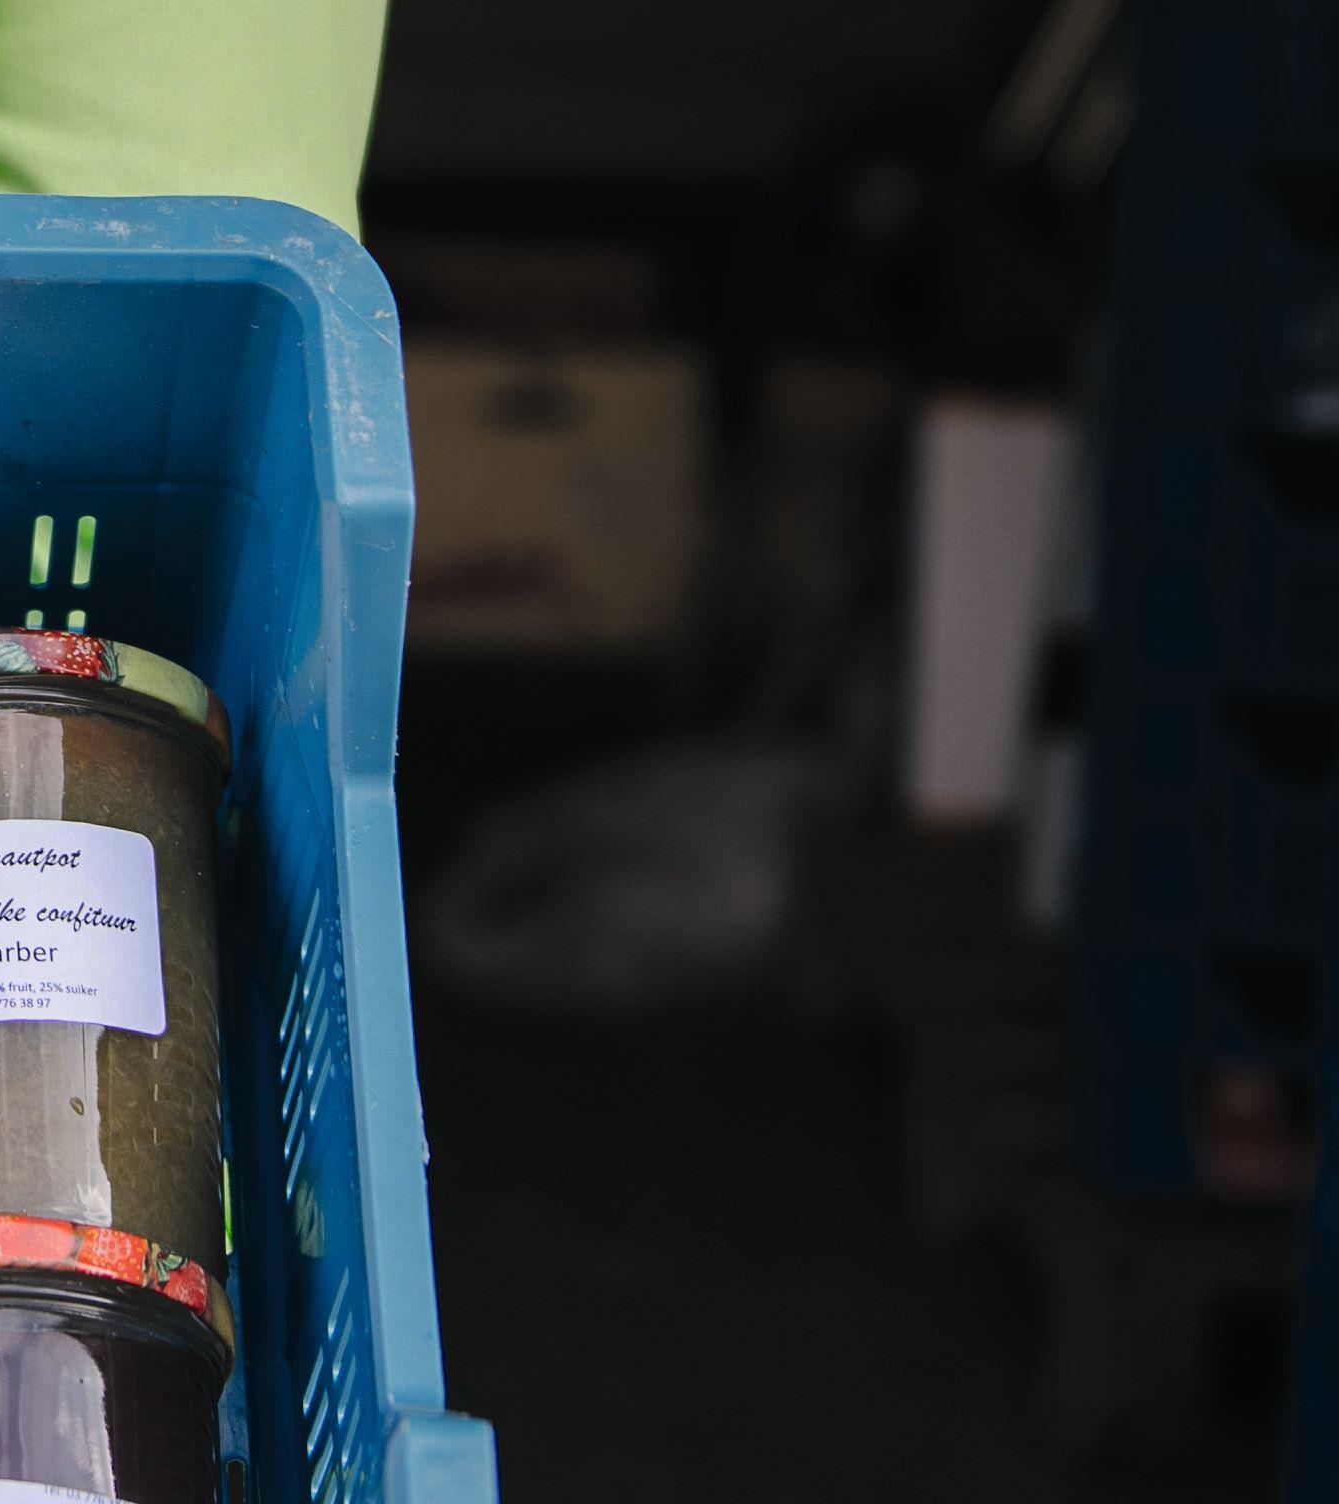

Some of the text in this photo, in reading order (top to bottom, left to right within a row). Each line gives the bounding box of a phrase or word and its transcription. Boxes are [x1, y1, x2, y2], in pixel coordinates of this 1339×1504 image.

[36, 901, 139, 934] confituur
[8, 981, 37, 993] fruit,
[39, 982, 63, 993] 25%
[65, 984, 98, 996] suiker
[19, 998, 33, 1008] 38
[37, 998, 51, 1009] 97
